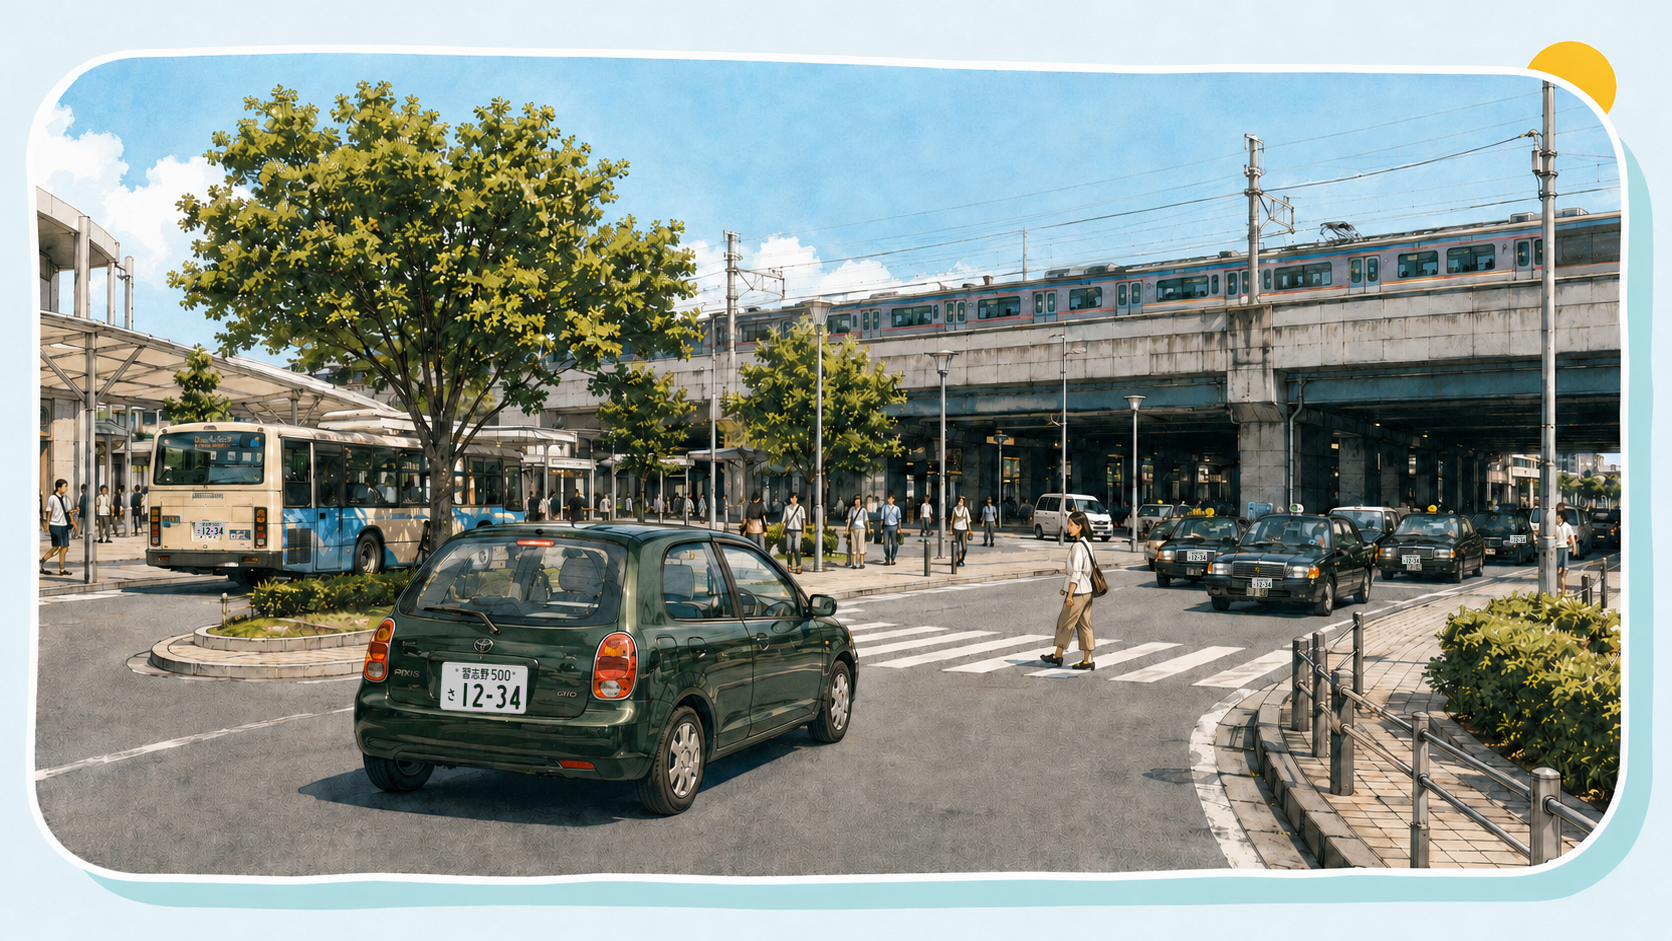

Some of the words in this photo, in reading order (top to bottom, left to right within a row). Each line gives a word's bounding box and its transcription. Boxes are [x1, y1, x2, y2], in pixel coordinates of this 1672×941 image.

[202, 527, 223, 535] 12-34
[394, 668, 420, 677] PIXIS
[462, 667, 489, 680] 習志野
[491, 669, 511, 681] 500
[447, 688, 455, 701] さ
[463, 683, 521, 710] 12-34
